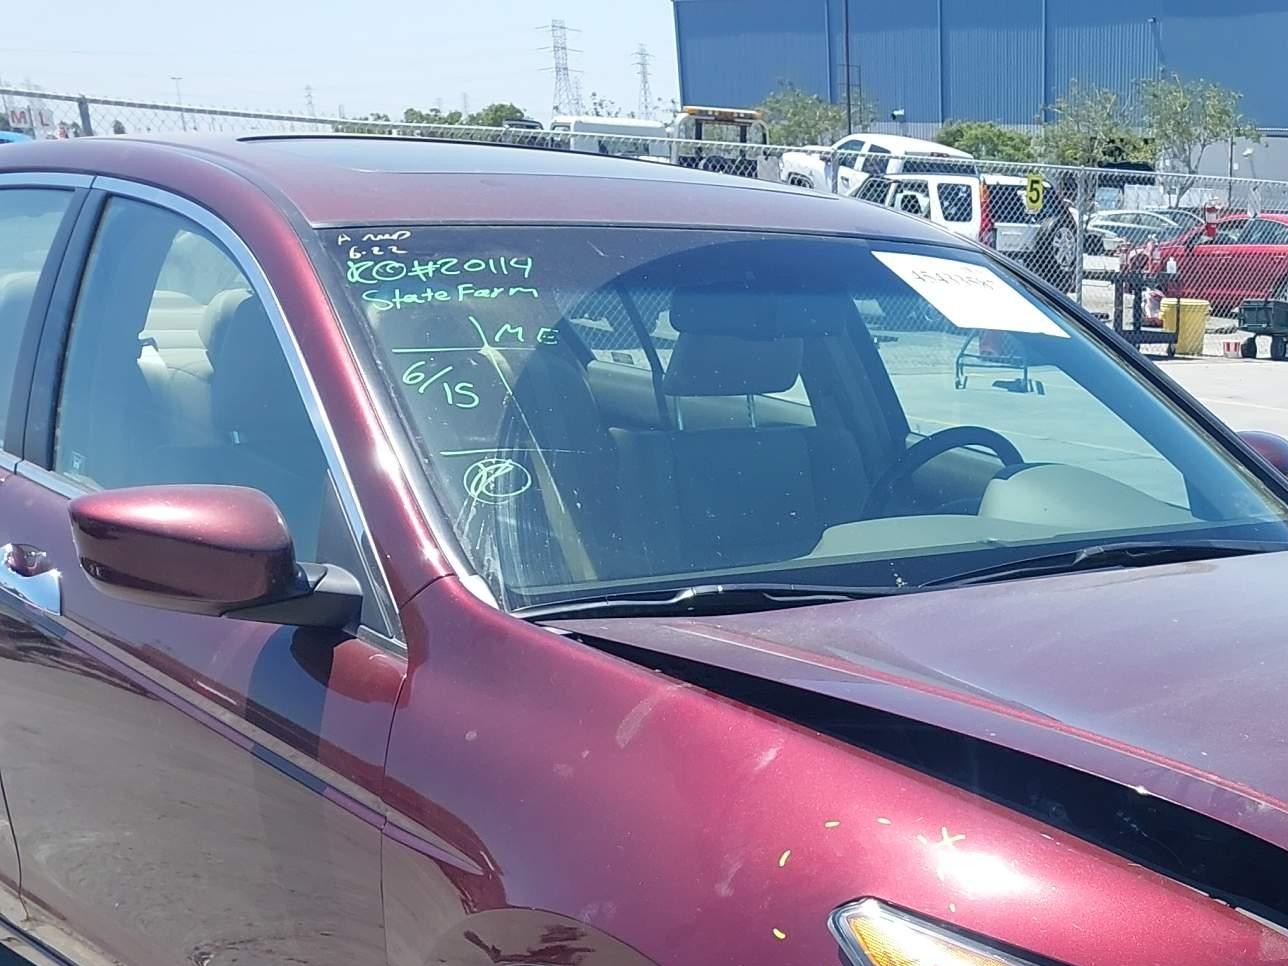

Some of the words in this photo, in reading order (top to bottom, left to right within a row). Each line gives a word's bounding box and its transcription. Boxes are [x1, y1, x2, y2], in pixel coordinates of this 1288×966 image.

[1028, 179, 1040, 204] 5
[362, 286, 451, 311] State
[457, 284, 539, 299] Farm
